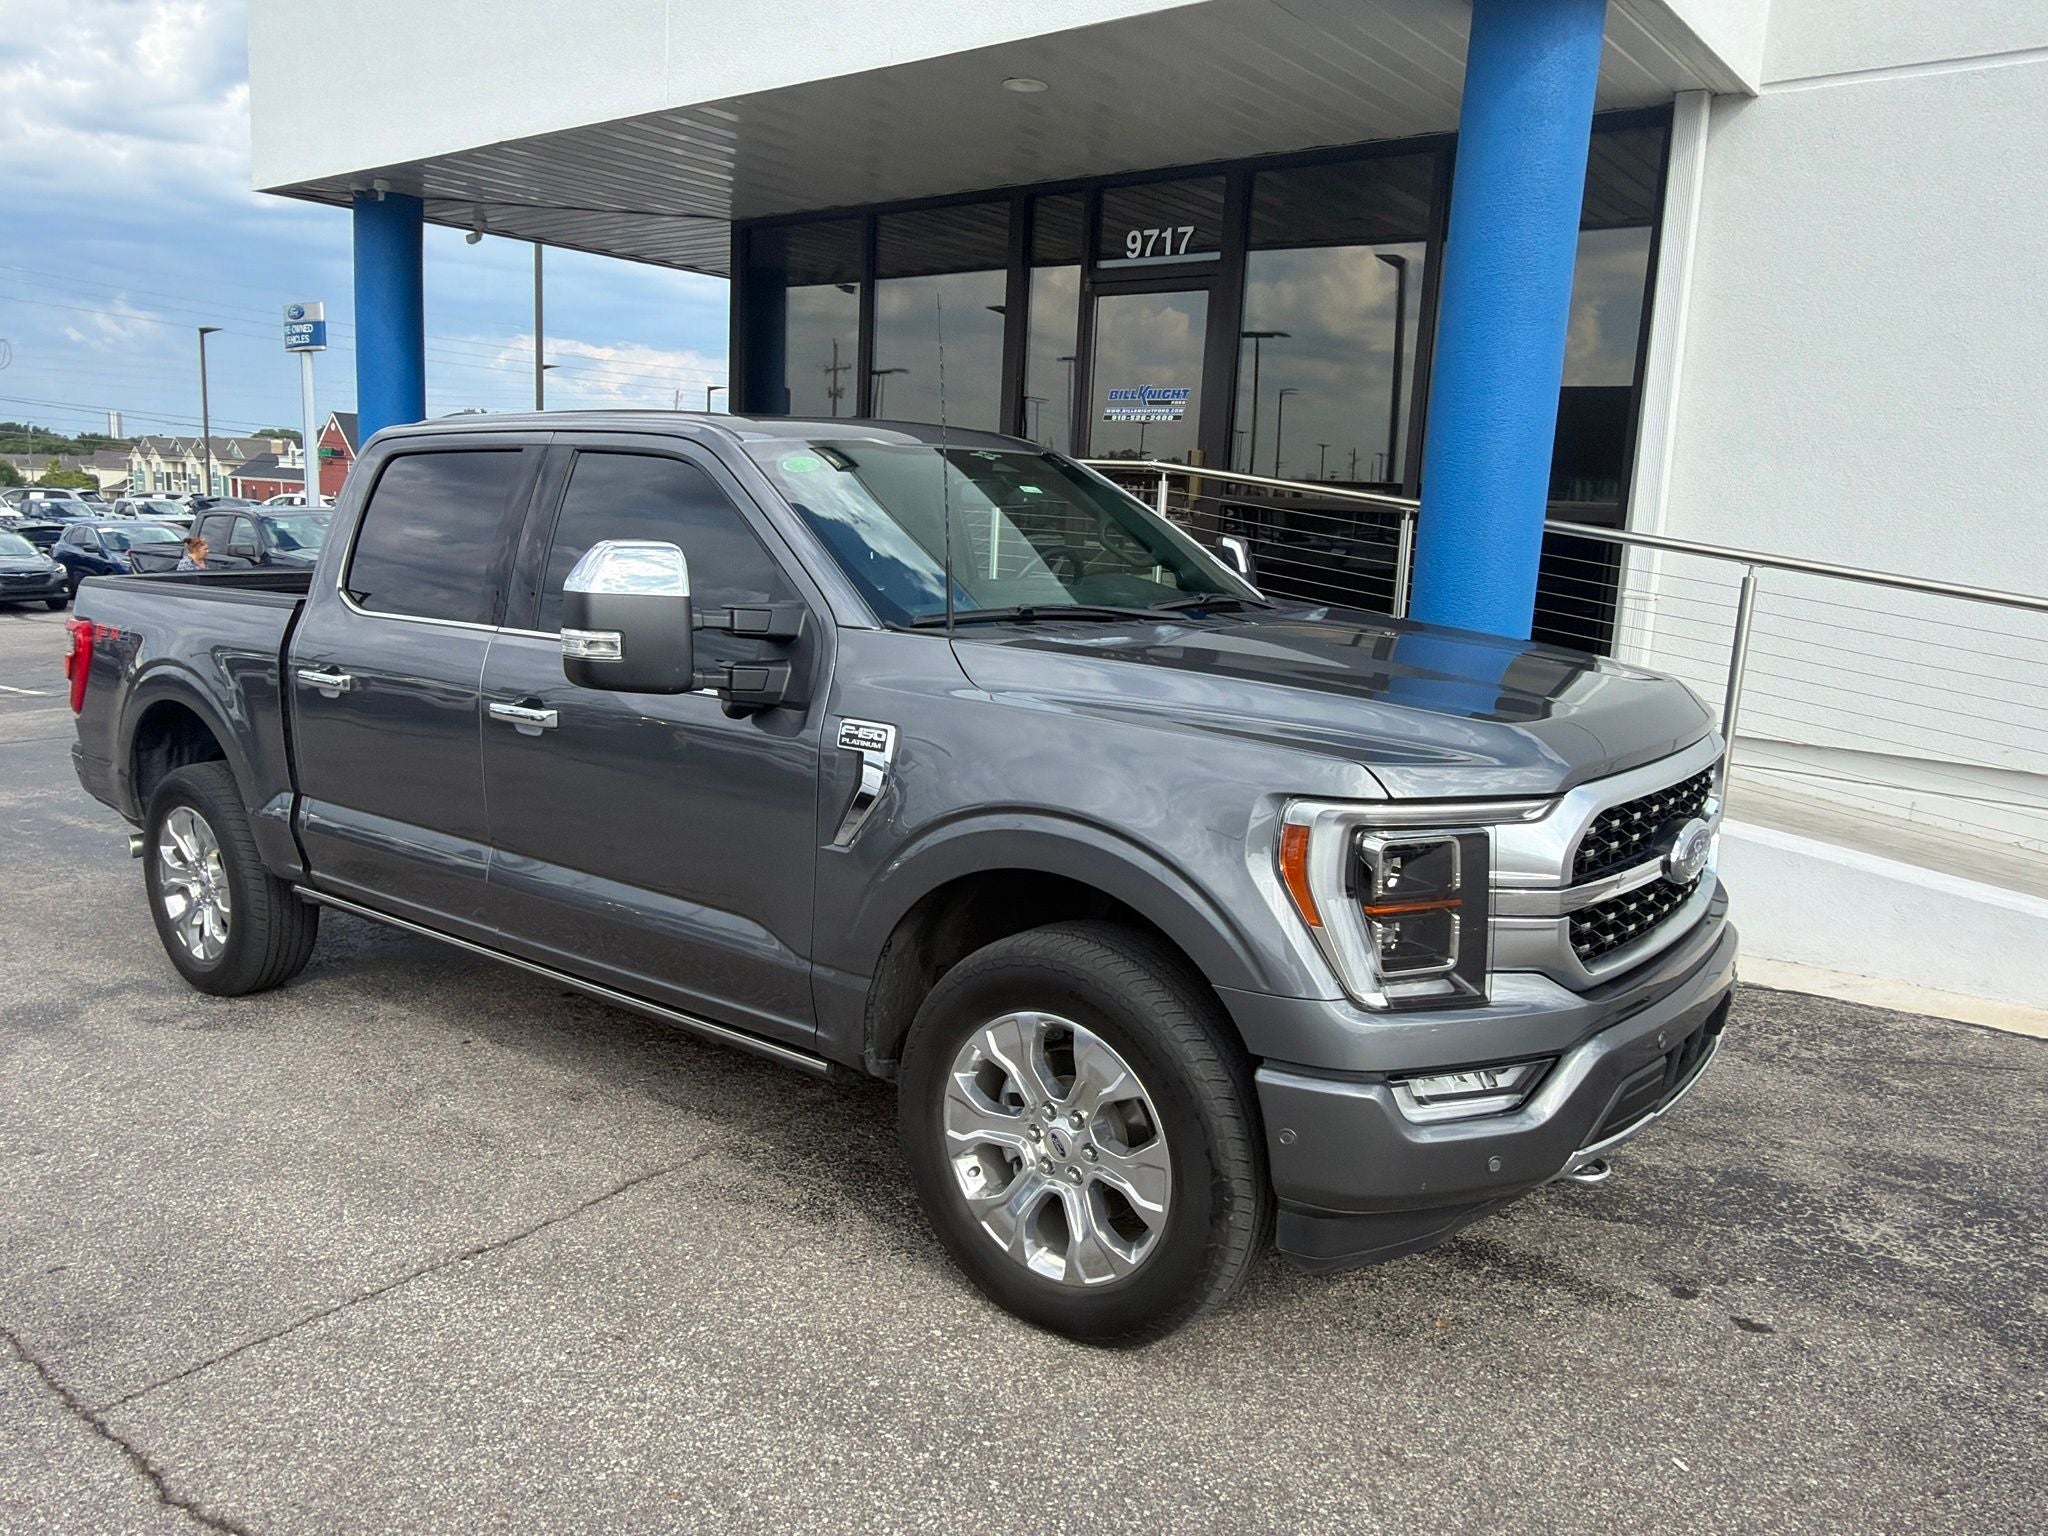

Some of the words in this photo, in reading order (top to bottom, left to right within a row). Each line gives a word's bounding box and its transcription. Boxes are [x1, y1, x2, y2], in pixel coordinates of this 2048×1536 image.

[1126, 226, 1194, 258] 9717
[841, 725, 886, 741] F-150
[841, 737, 881, 748] PLATINUM
